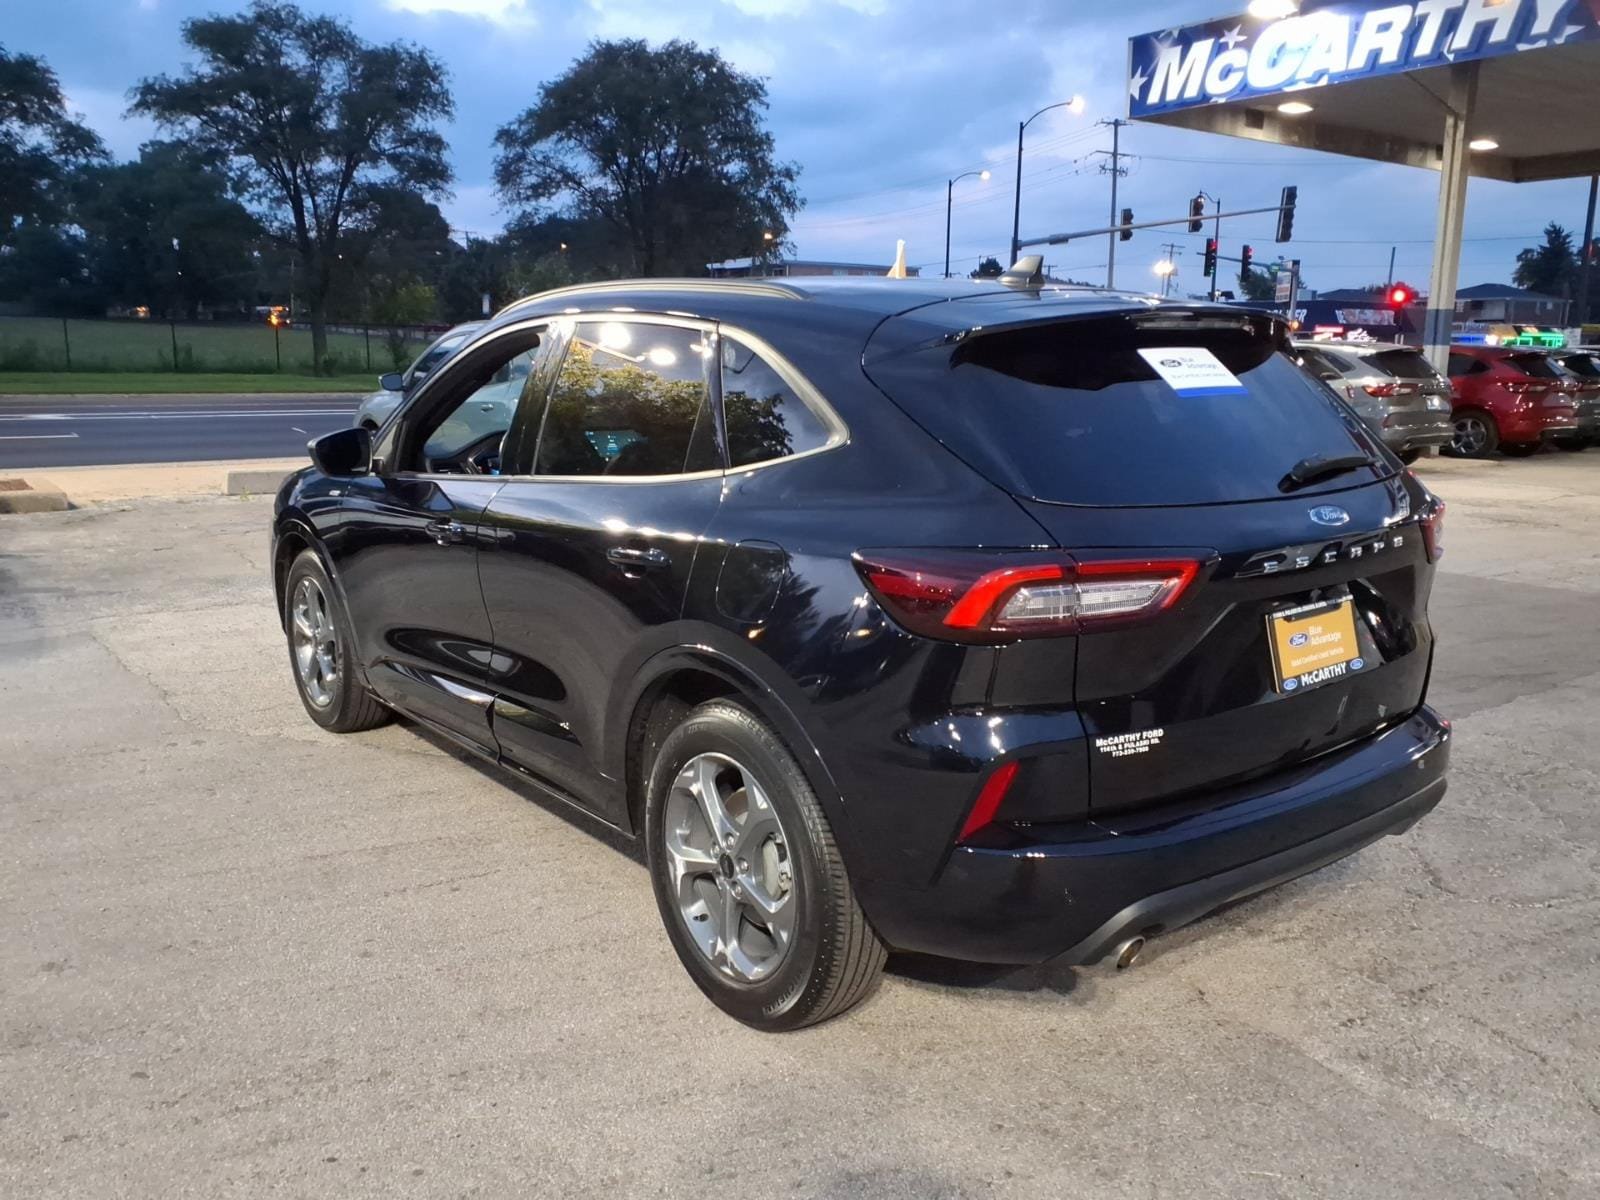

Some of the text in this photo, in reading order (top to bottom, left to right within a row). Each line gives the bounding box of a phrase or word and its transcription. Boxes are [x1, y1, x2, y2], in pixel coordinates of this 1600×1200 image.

[1145, 0, 1571, 105] McCARTHY
[1263, 536, 1404, 574] ESCAPE
[1301, 661, 1347, 687] McCARTHY
[1096, 728, 1164, 747] McCARTHY FORD
